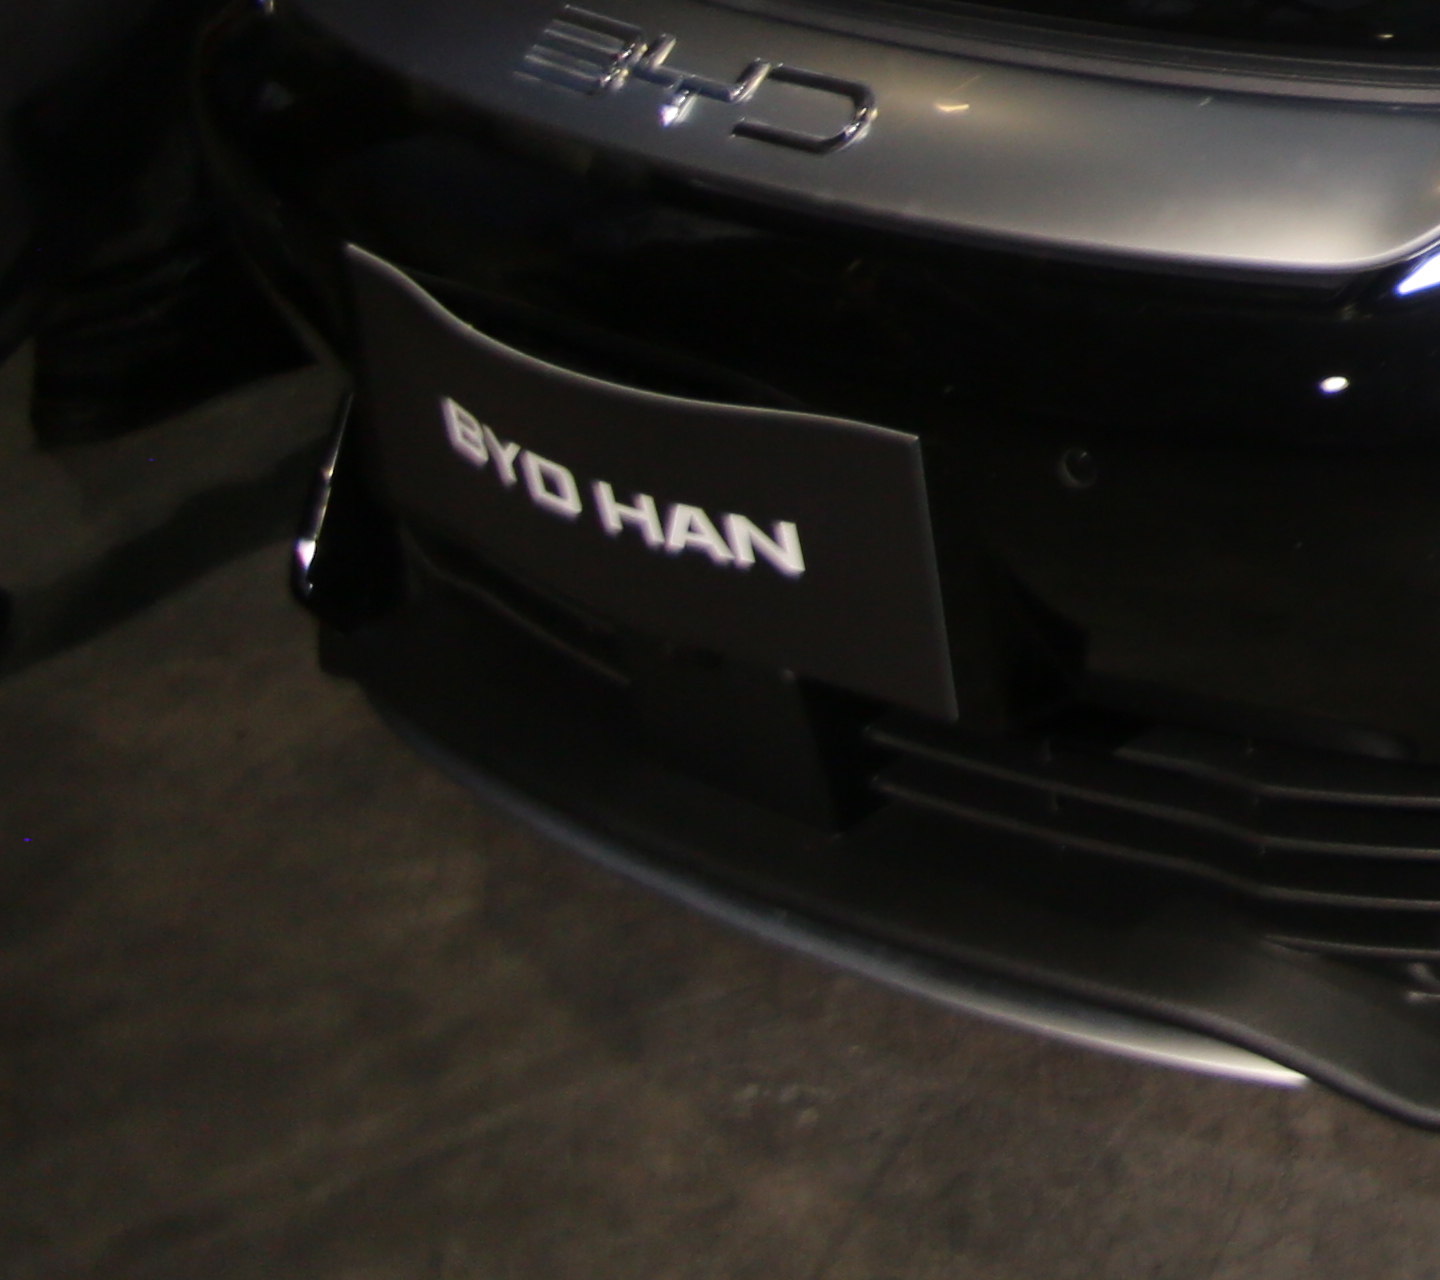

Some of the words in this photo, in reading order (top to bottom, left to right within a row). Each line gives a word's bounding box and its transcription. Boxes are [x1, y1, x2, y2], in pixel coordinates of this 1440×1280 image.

[512, 3, 878, 156] BYD
[441, 396, 582, 519] BYD
[592, 480, 807, 577] HAN
